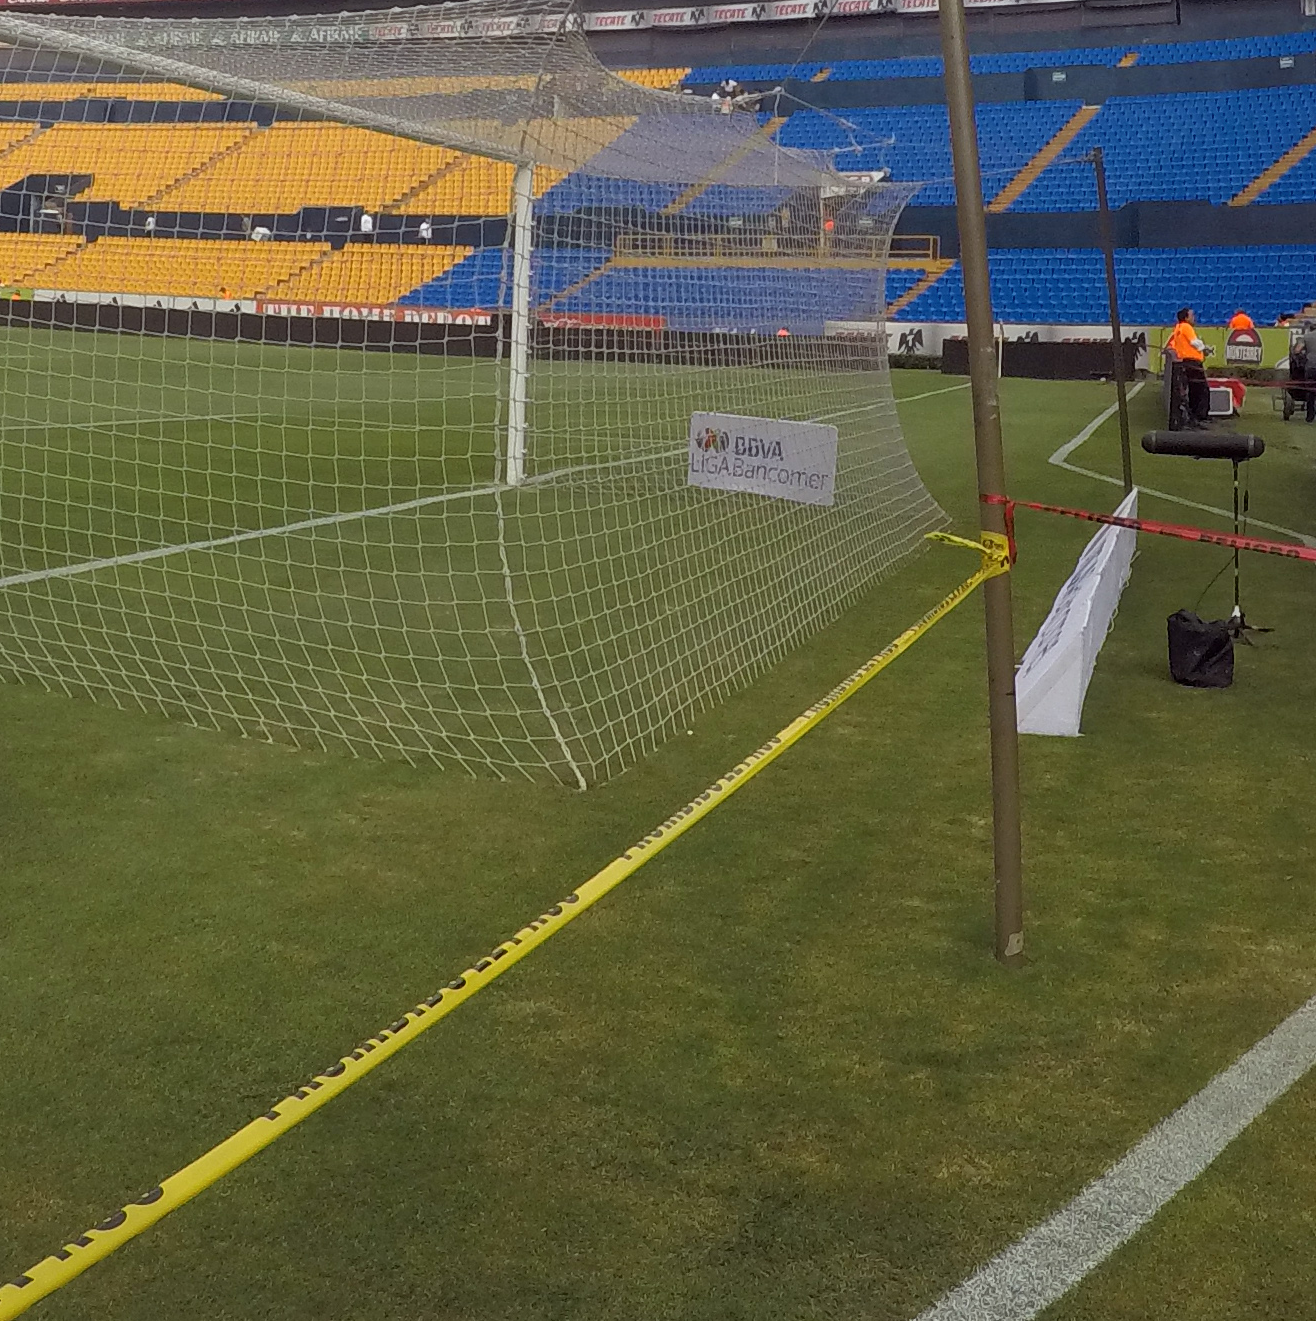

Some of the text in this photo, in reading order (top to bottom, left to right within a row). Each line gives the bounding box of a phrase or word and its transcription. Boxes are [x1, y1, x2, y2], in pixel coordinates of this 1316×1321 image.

[775, 4, 809, 15] TECATE
[837, 0, 873, 12] TECATE
[653, 13, 685, 24] TECATE
[713, 8, 748, 19] TECATE
[595, 15, 627, 26] TECATE
[734, 436, 784, 461] BBVA
